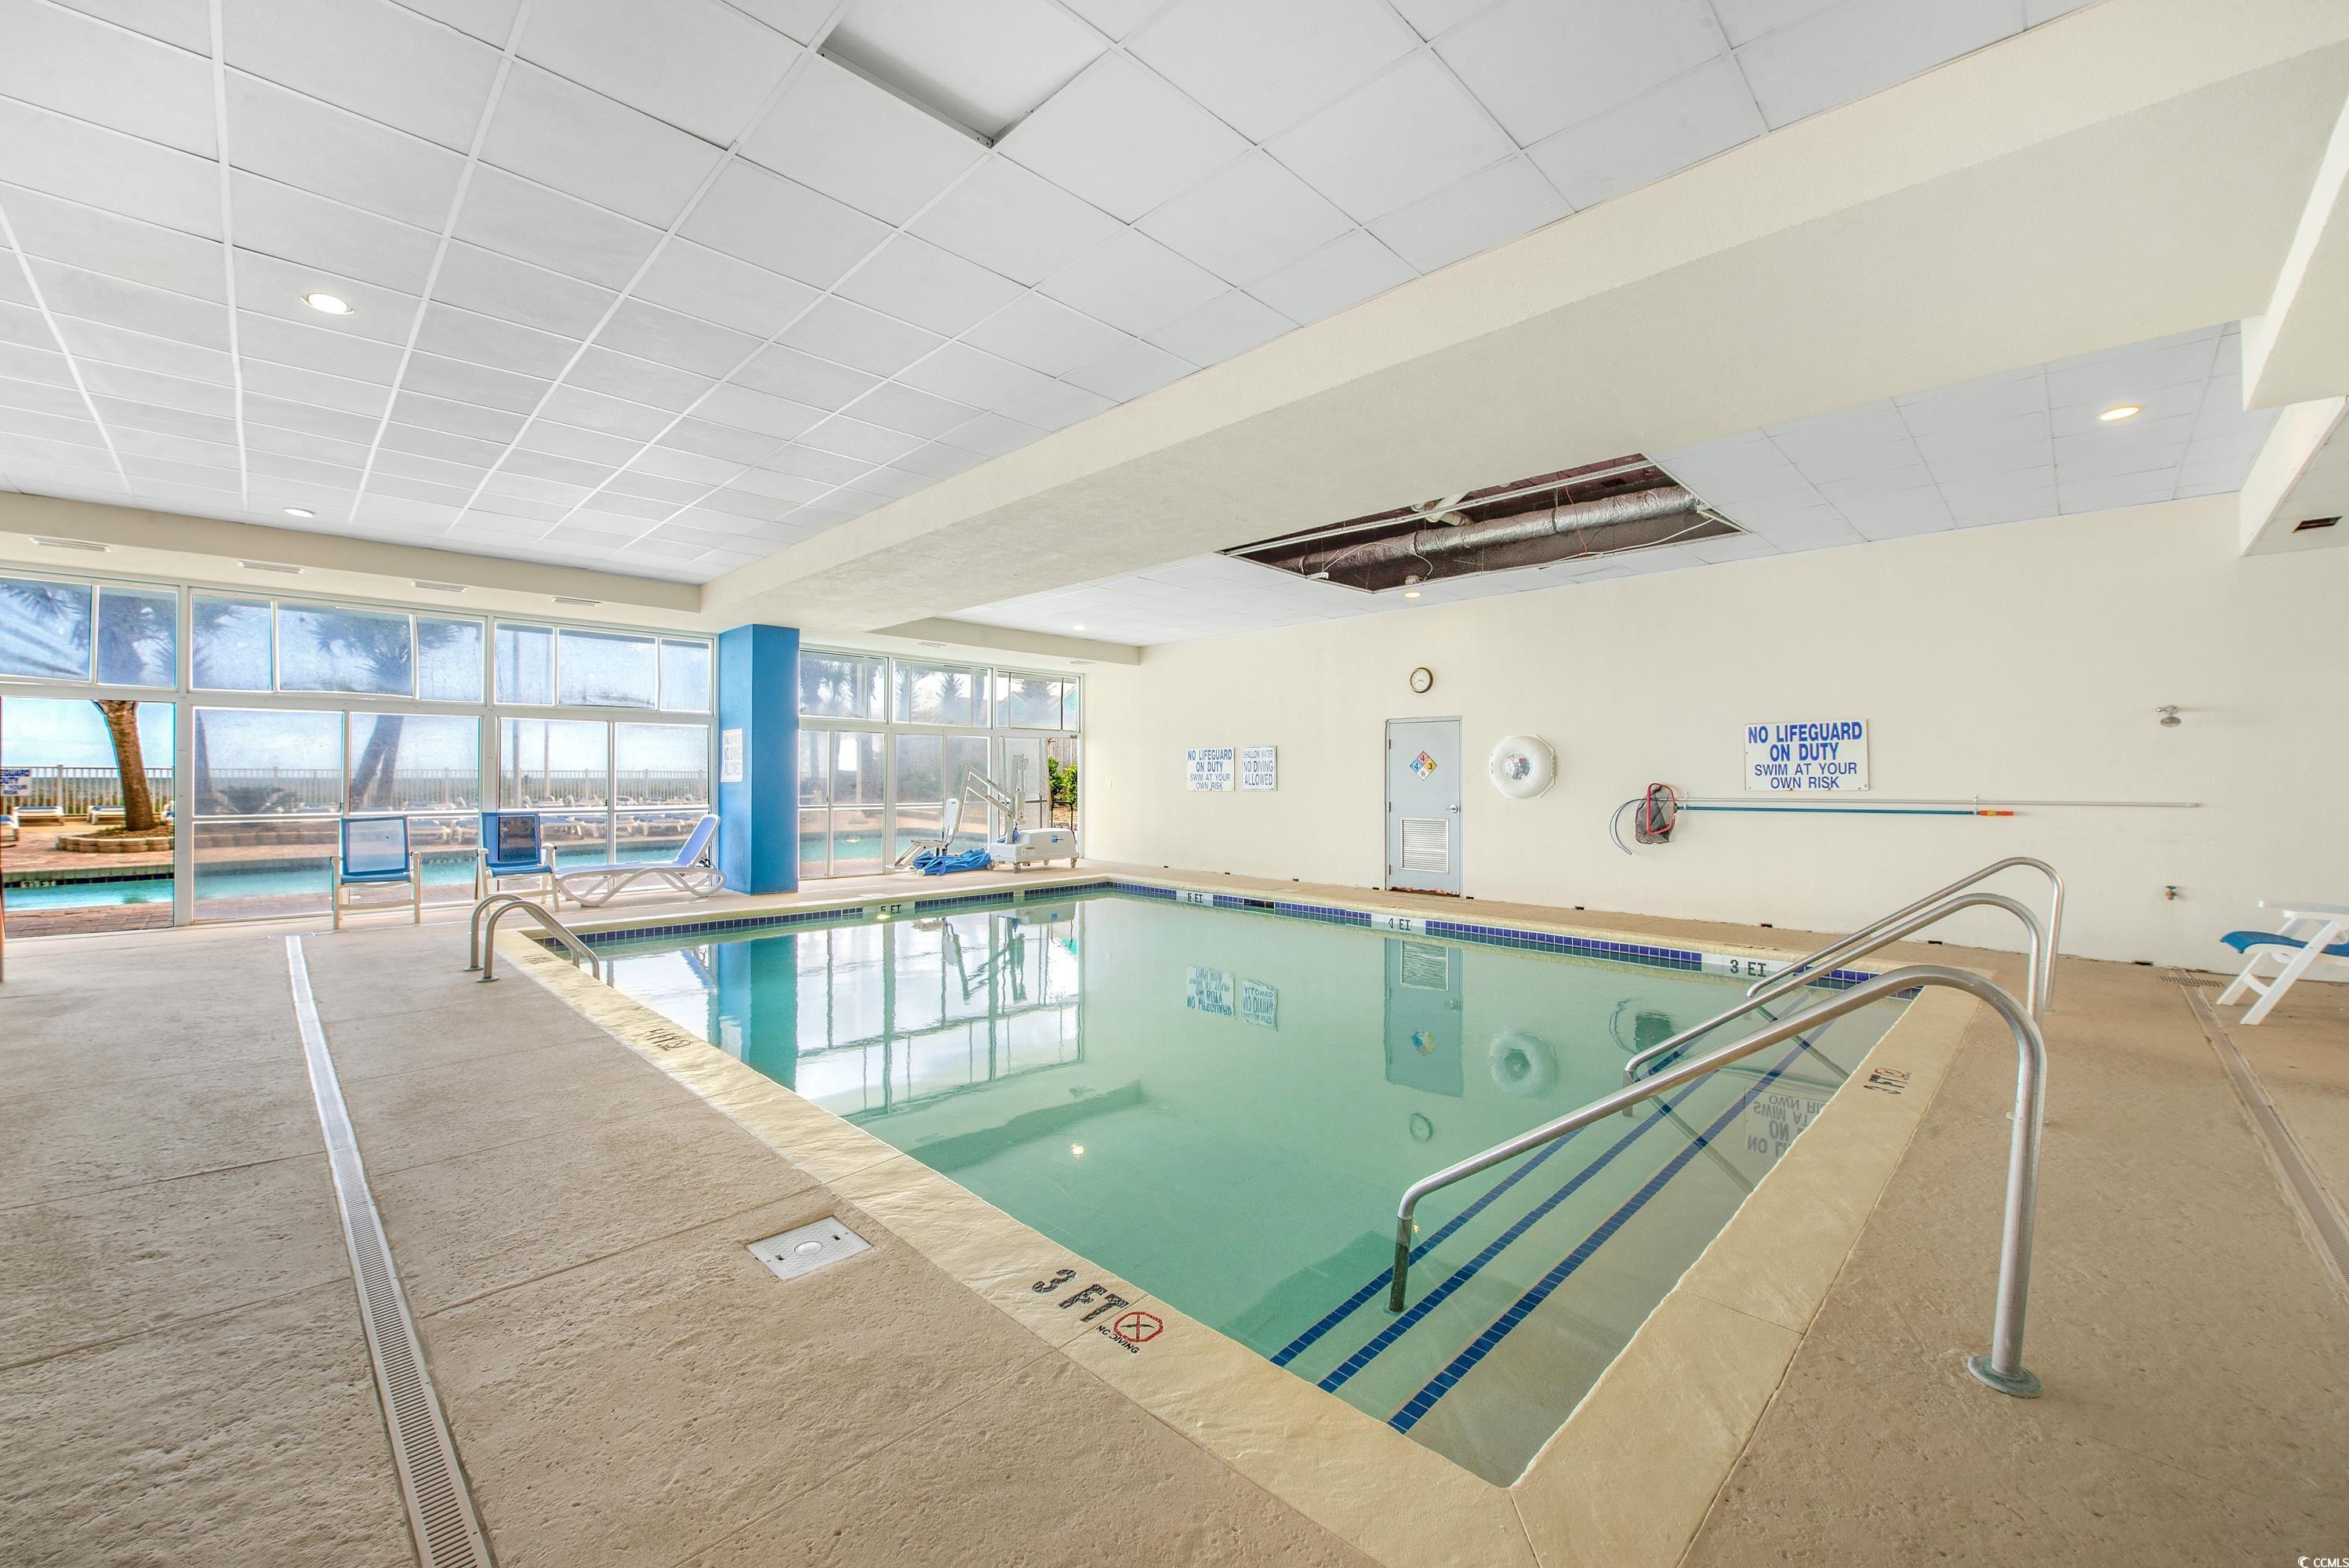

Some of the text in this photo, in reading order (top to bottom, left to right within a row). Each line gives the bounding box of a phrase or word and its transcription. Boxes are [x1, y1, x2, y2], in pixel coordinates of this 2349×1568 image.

[1748, 721, 1862, 744] NO LIFEGUARD
[1188, 749, 1233, 760] NO LIFEGUARD
[1243, 750, 1273, 759] SHALLOW WATER
[1770, 742, 1839, 762] ON DUTY
[1196, 761, 1224, 772] ON DUTY
[1243, 760, 1273, 772] NO DIVING
[1755, 762, 1857, 776] SWIM AT YOUR
[1189, 773, 1204, 782] SWIM
[1244, 774, 1273, 786] ALLOWED
[1770, 776, 1840, 789] OWN RISK
[1196, 782, 1223, 790] OWN RISK
[1730, 959, 1739, 974] 3
[1031, 1268, 1130, 1323] 3 FT
